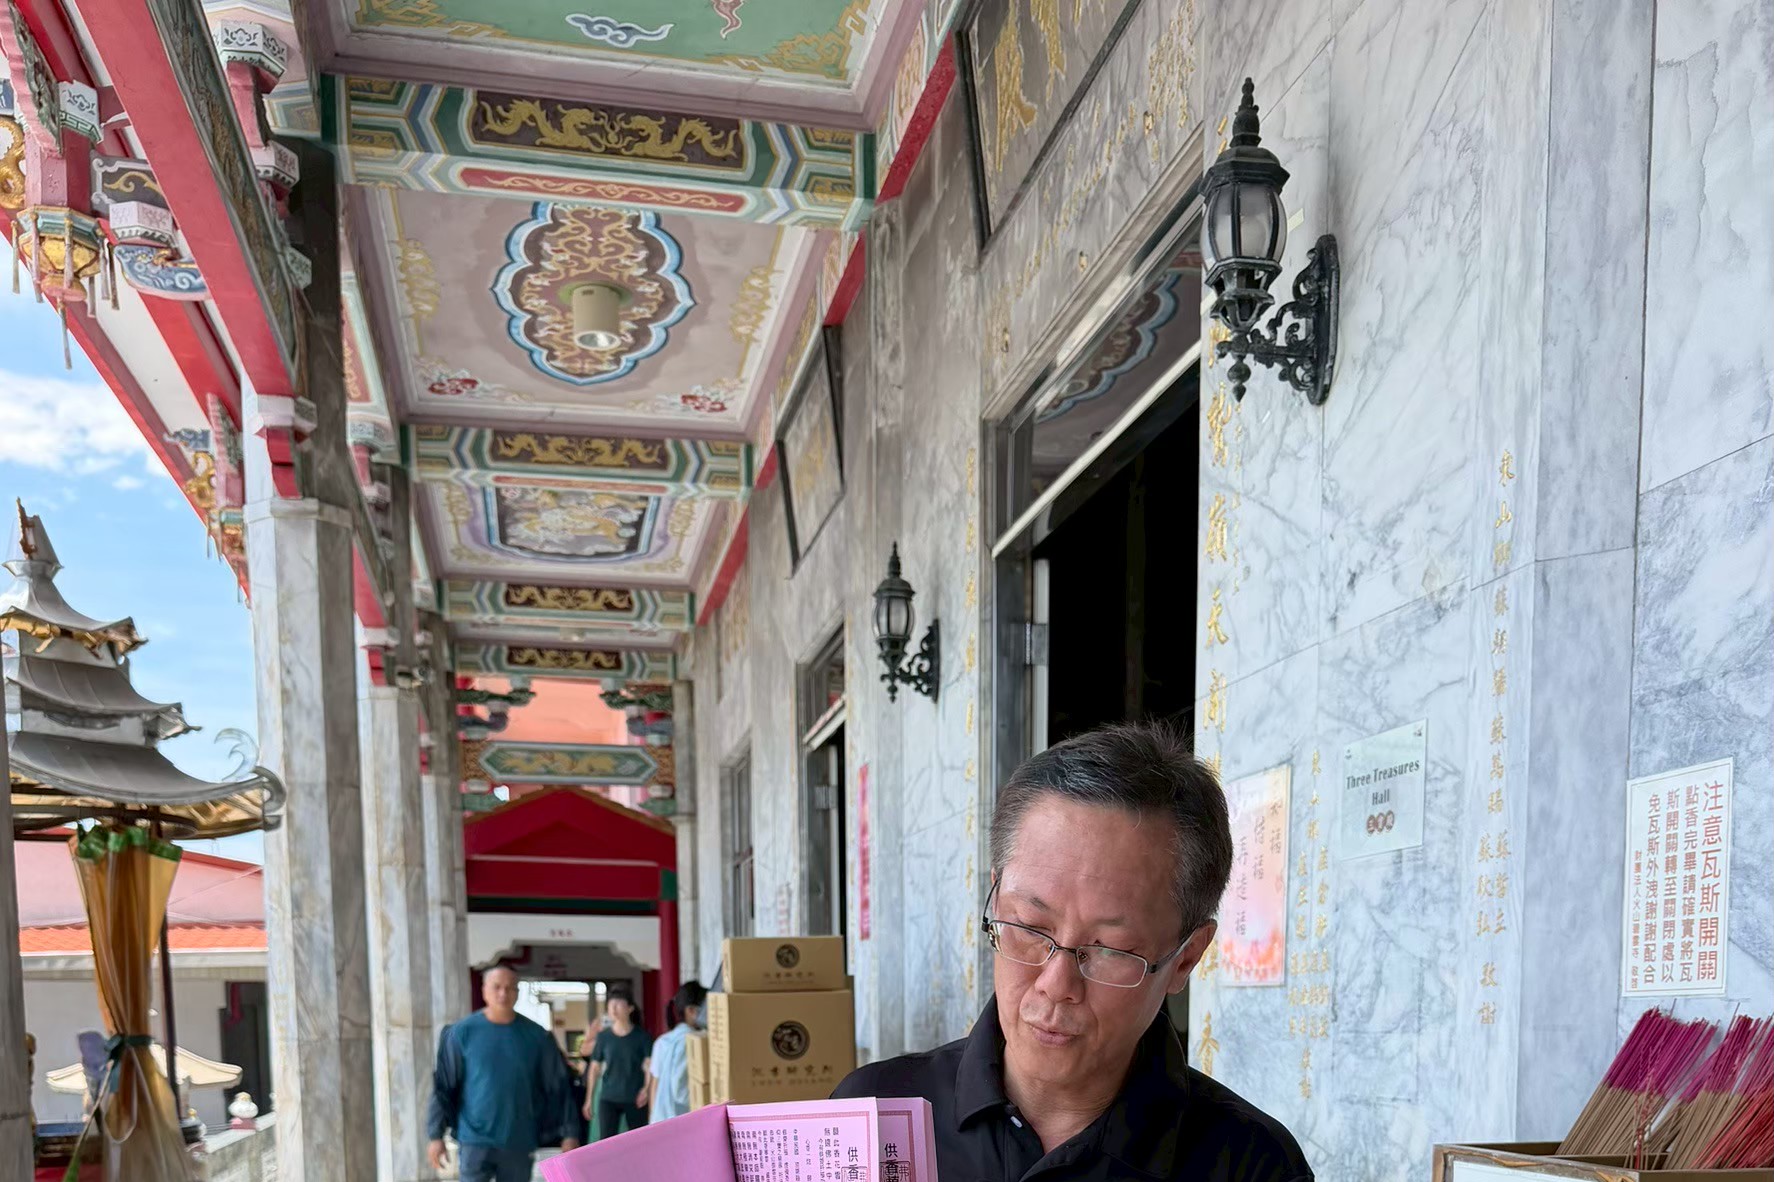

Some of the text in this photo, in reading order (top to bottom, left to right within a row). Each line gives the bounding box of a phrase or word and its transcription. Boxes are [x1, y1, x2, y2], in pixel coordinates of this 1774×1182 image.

[1346, 760, 1420, 790] Three Treasures
[1372, 788, 1390, 806] Hall
[1661, 787, 1680, 983] 斯開關轉至關閉處以
[1679, 784, 1700, 982] 點香完畢請確實將瓦
[1697, 780, 1724, 981] 注意瓦斯開關
